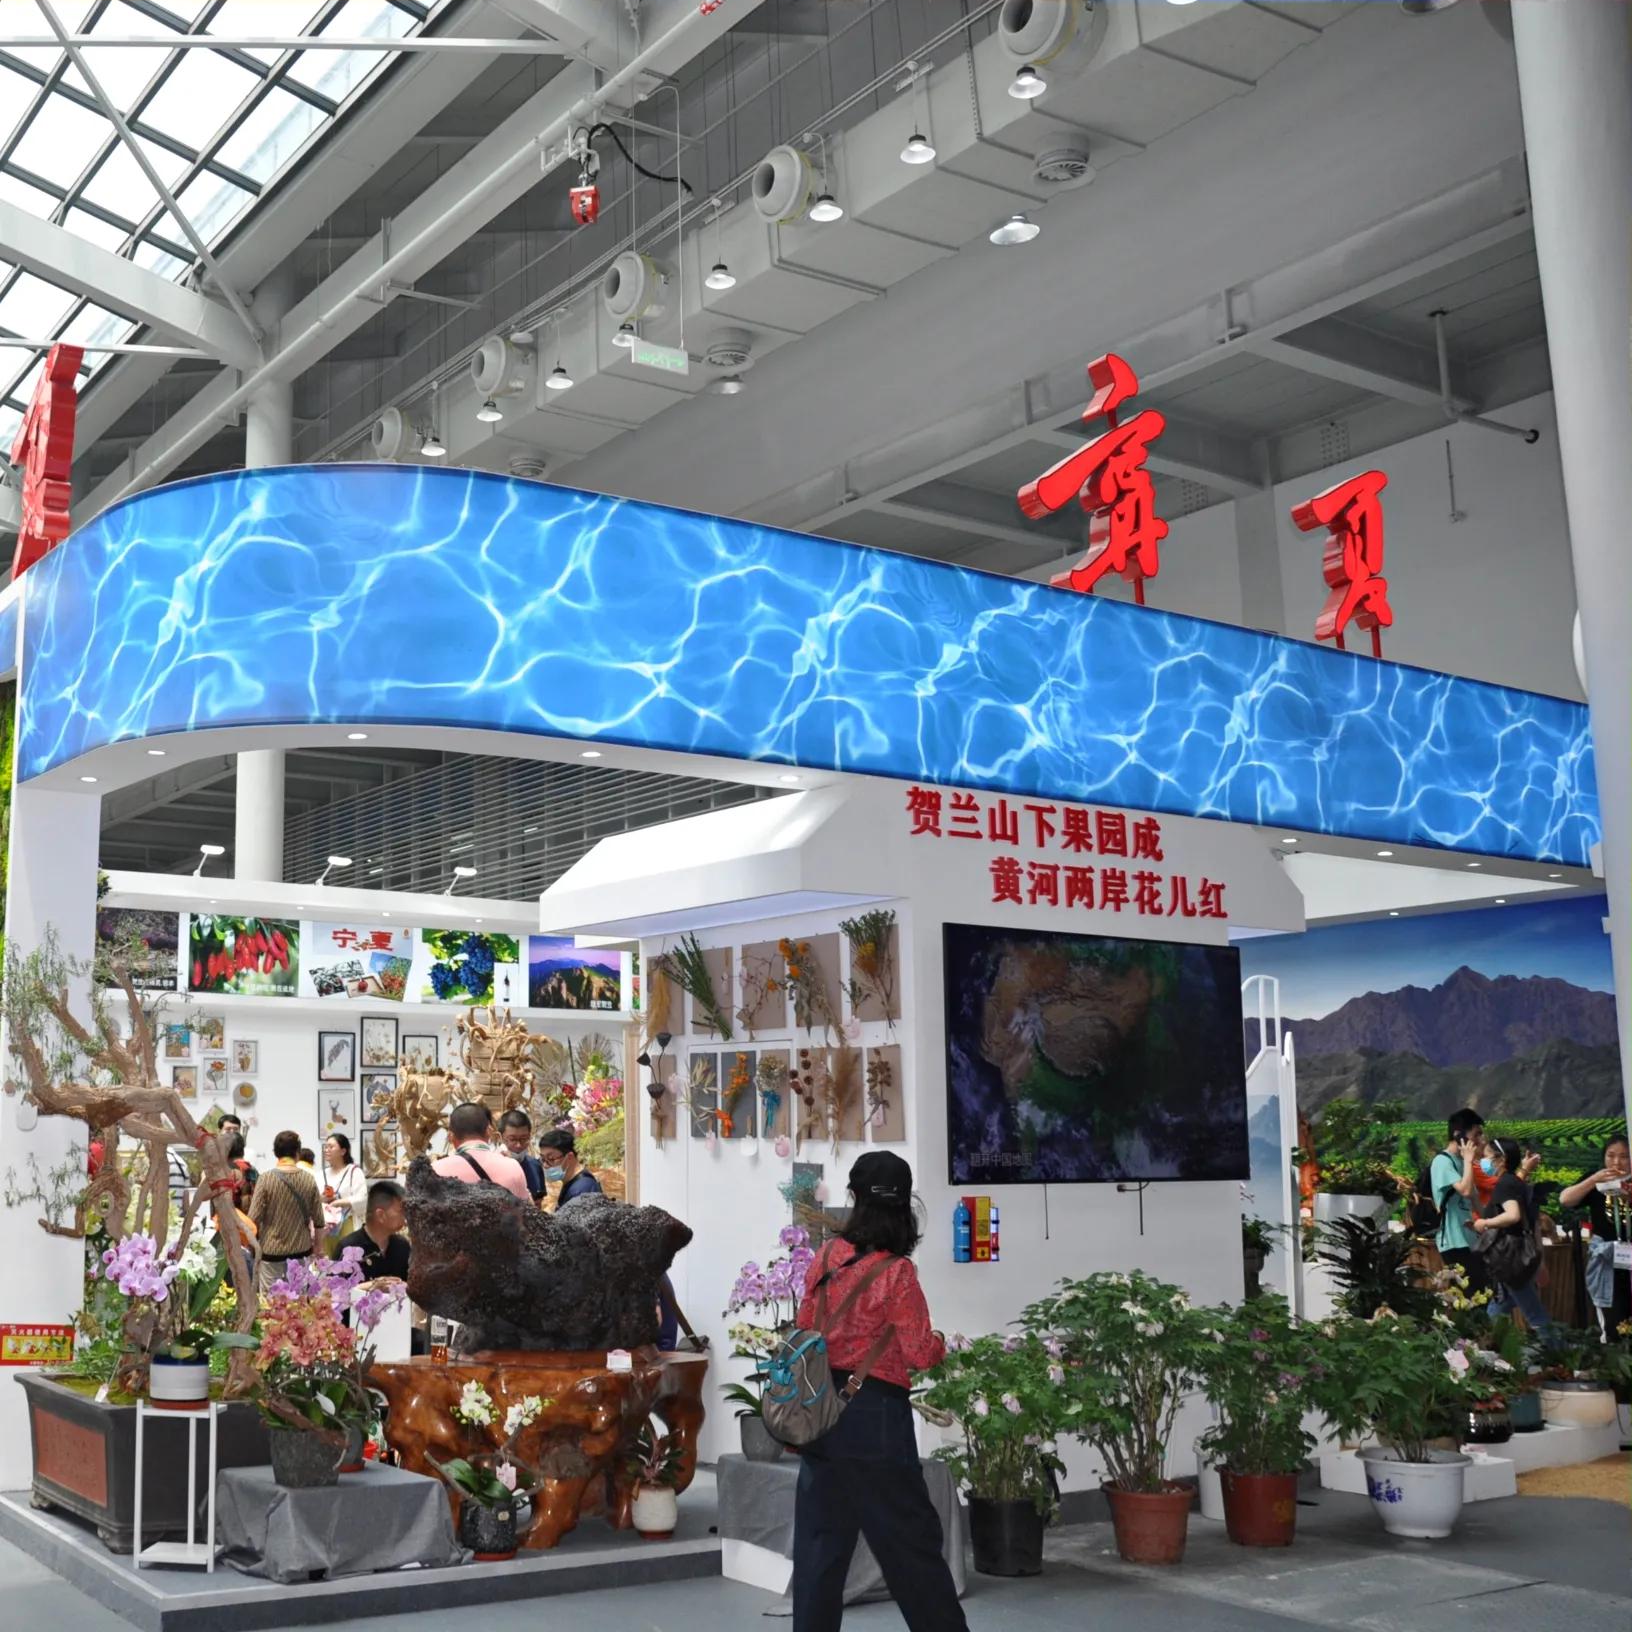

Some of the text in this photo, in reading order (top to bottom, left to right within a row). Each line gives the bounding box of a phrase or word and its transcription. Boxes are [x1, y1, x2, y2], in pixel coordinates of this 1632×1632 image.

[904, 785, 1166, 863] 贺兰山下果园成
[987, 855, 1230, 919] 黄河两岸花儿红
